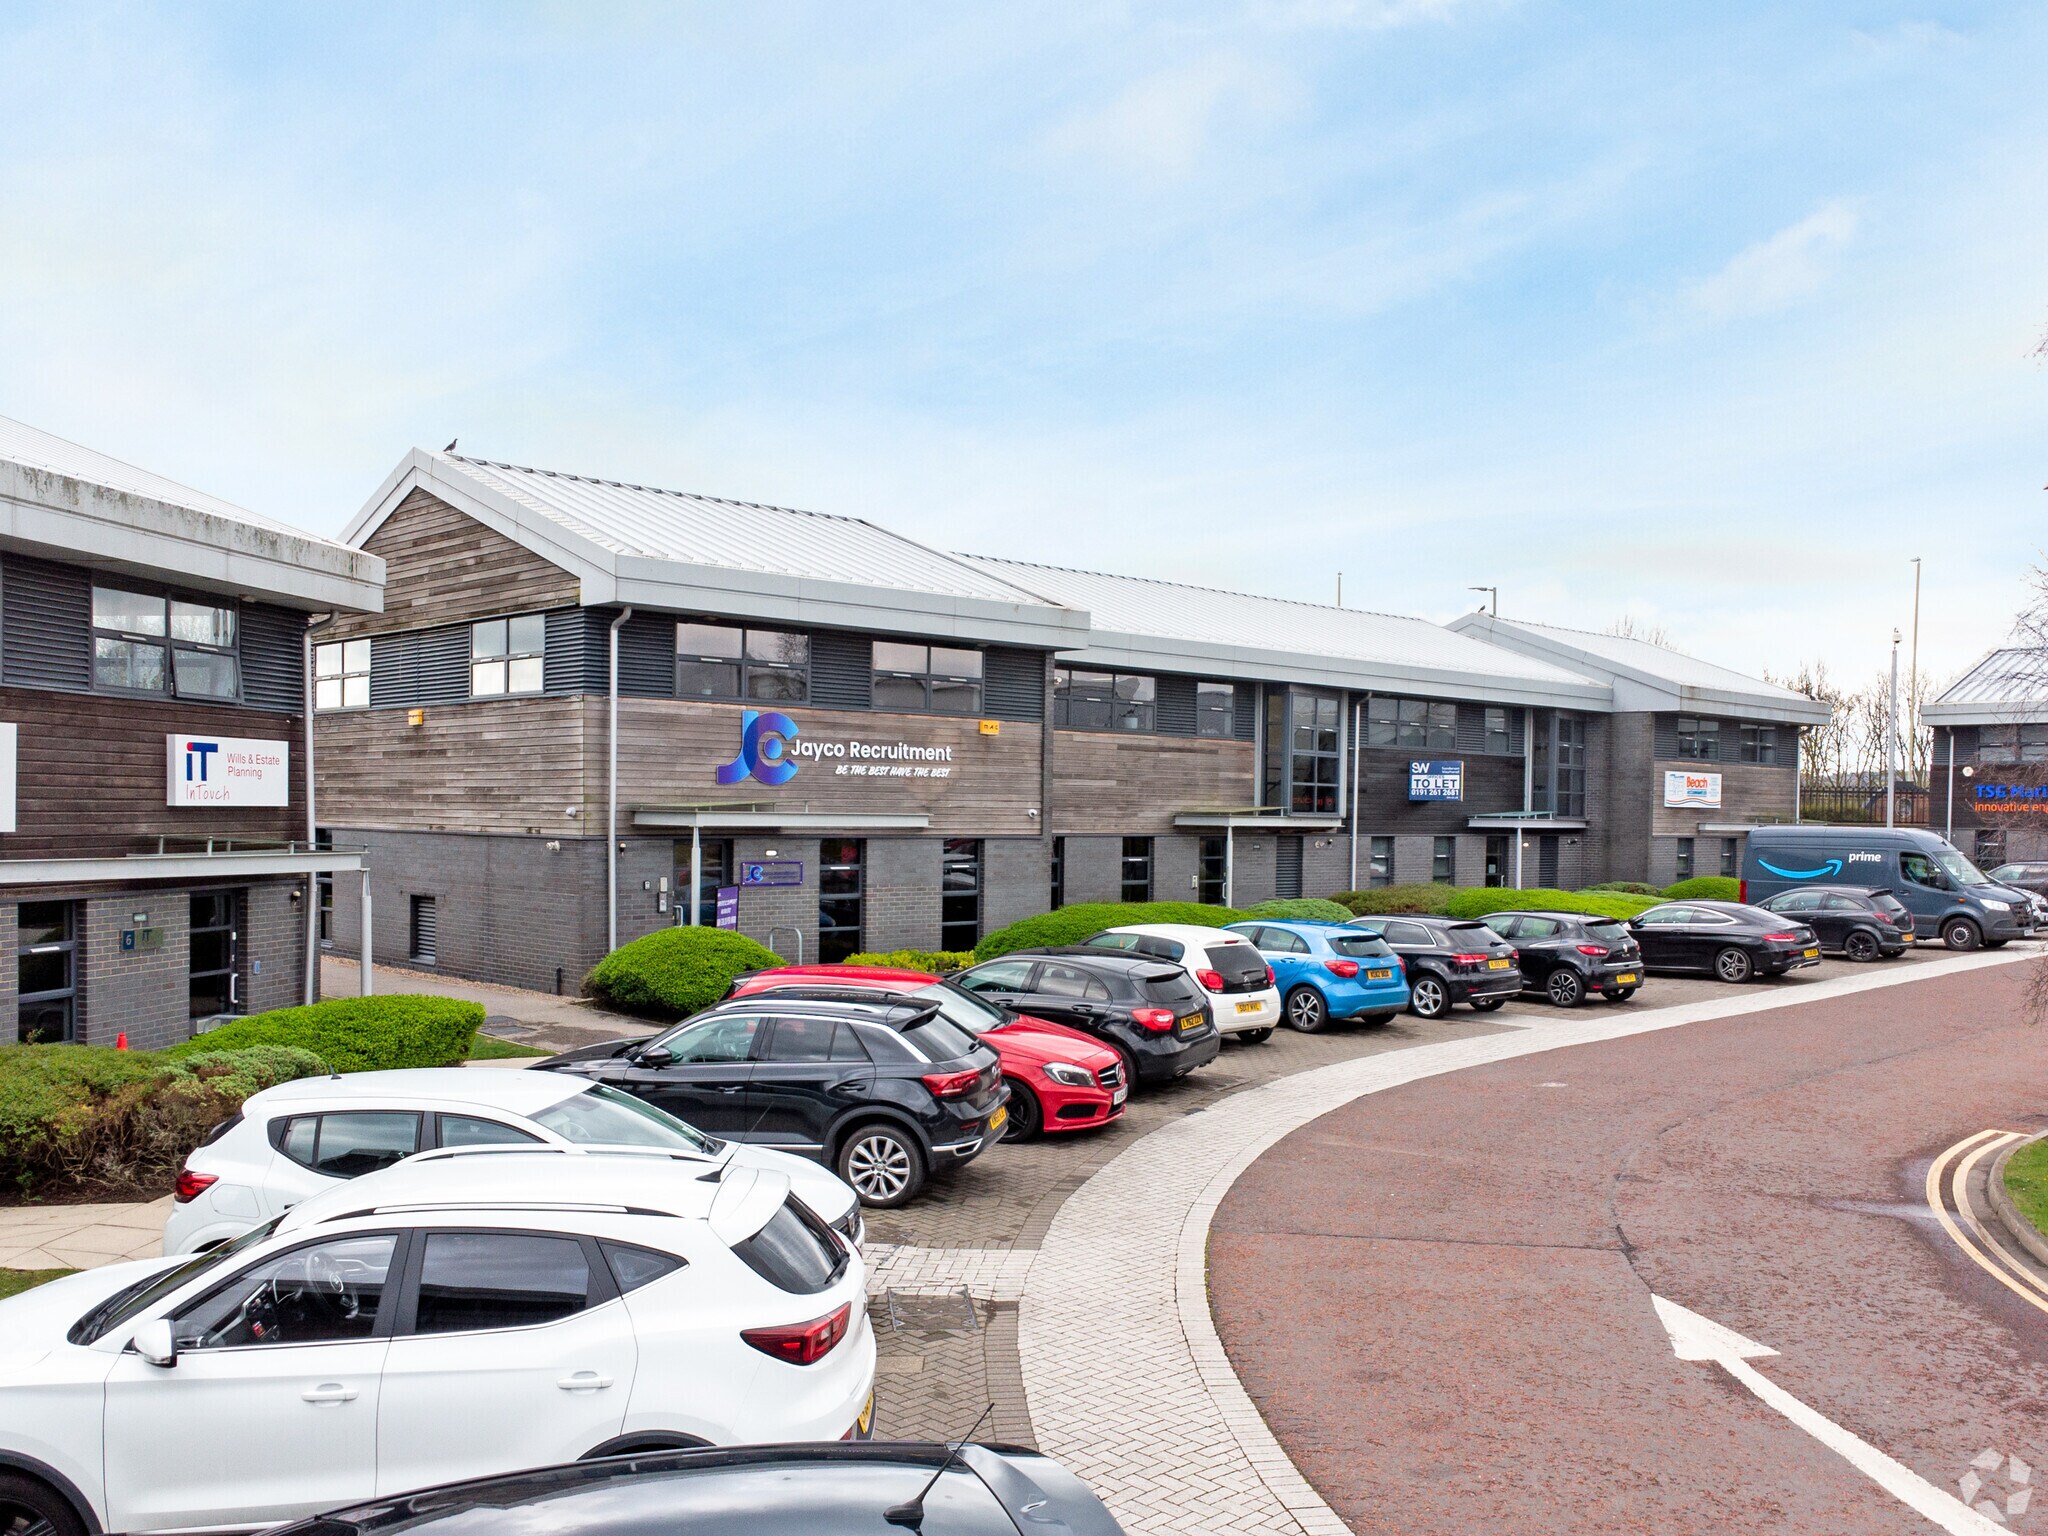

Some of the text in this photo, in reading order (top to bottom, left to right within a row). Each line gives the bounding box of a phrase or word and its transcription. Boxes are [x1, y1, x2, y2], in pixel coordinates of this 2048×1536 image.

[790, 739, 952, 762] Jayco Recruitment
[227, 753, 280, 765] Wills & Estate
[228, 766, 262, 780] Planning
[835, 765, 951, 777] BE THE BEST HAVE THE BEST
[1411, 762, 1430, 773] SW
[1413, 779, 1457, 788] TO LET
[1686, 776, 1707, 788] Beach
[186, 784, 230, 800] InTouch
[1975, 784, 2007, 798] TSG
[1974, 801, 2029, 812] innovative
[1848, 851, 1881, 863] prime
[125, 934, 132, 946] 6
